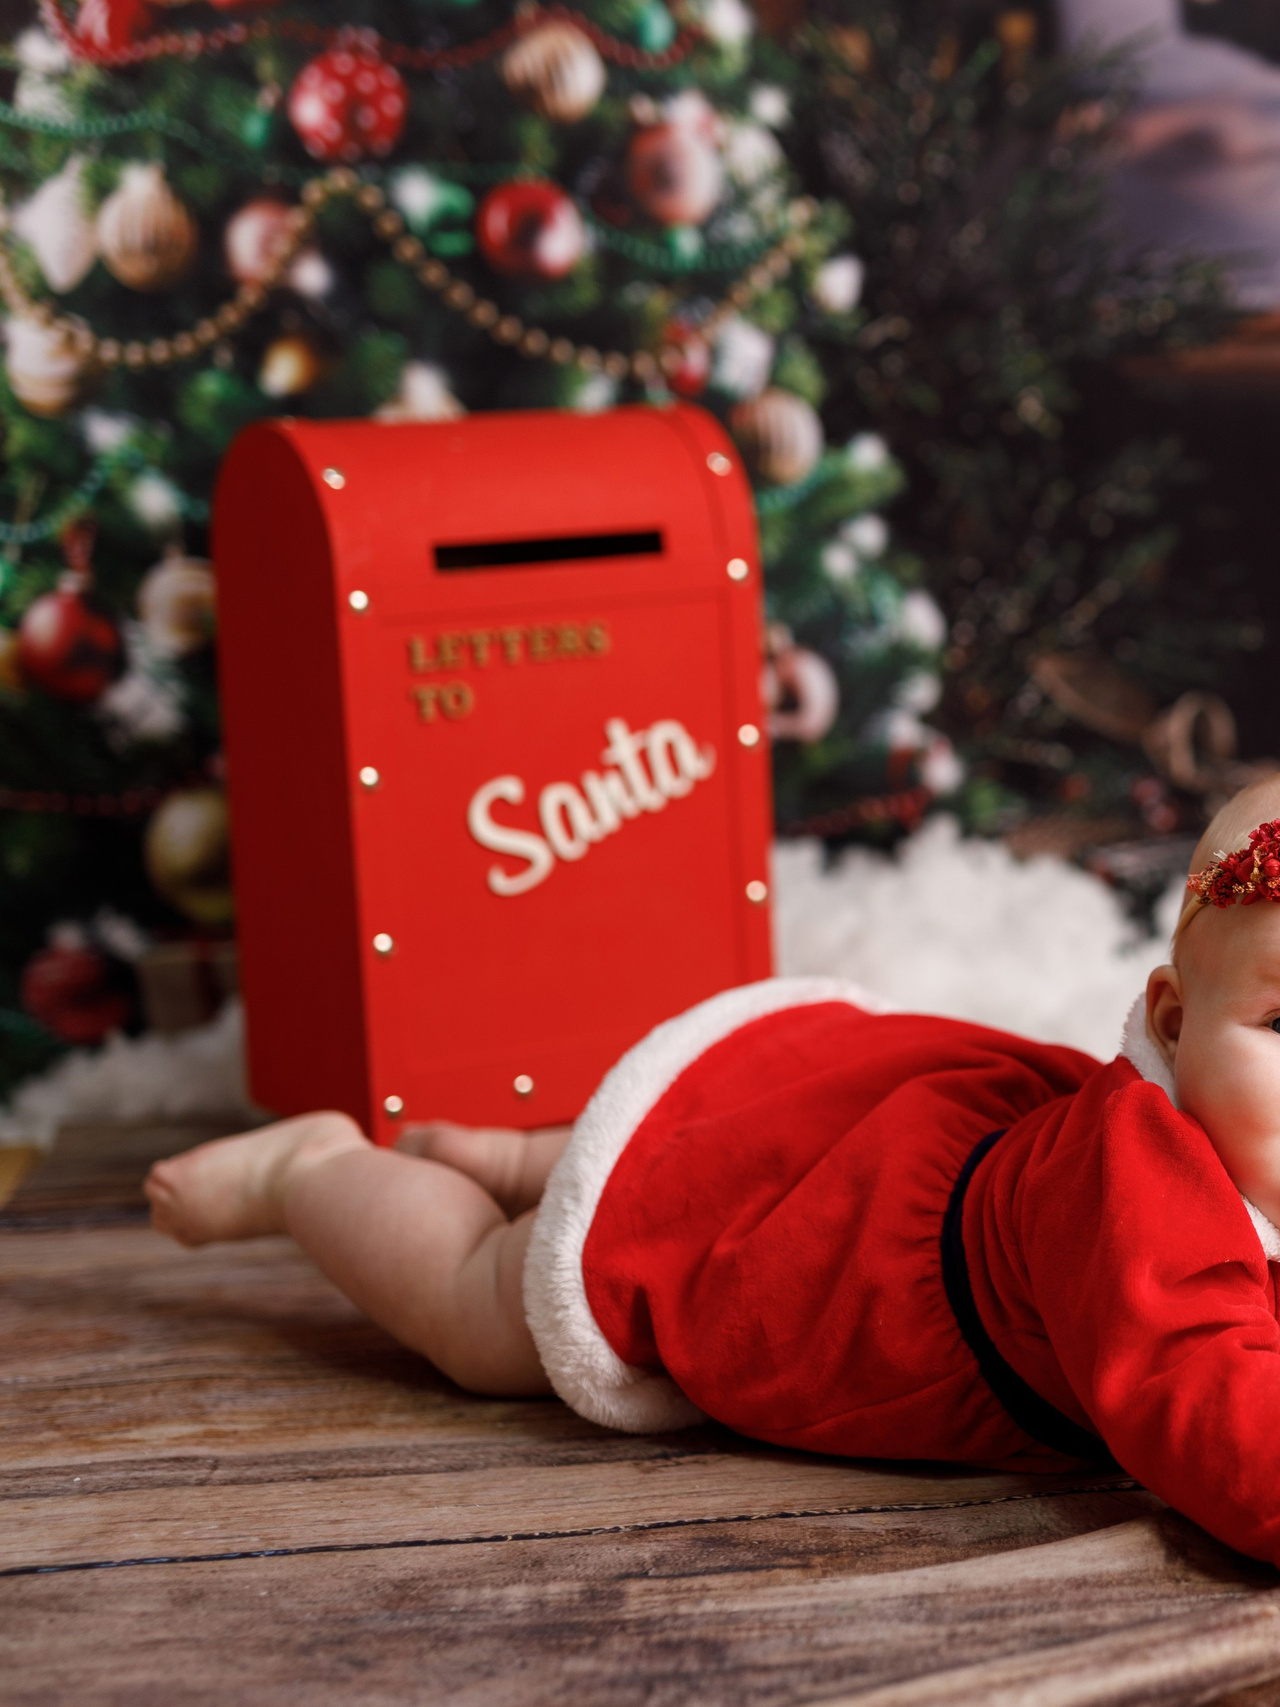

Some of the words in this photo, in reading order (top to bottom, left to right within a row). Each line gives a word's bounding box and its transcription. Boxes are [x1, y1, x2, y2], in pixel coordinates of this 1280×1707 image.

[408, 621, 611, 671] LETTERS
[411, 681, 473, 722] TO
[467, 717, 716, 897] Santa
